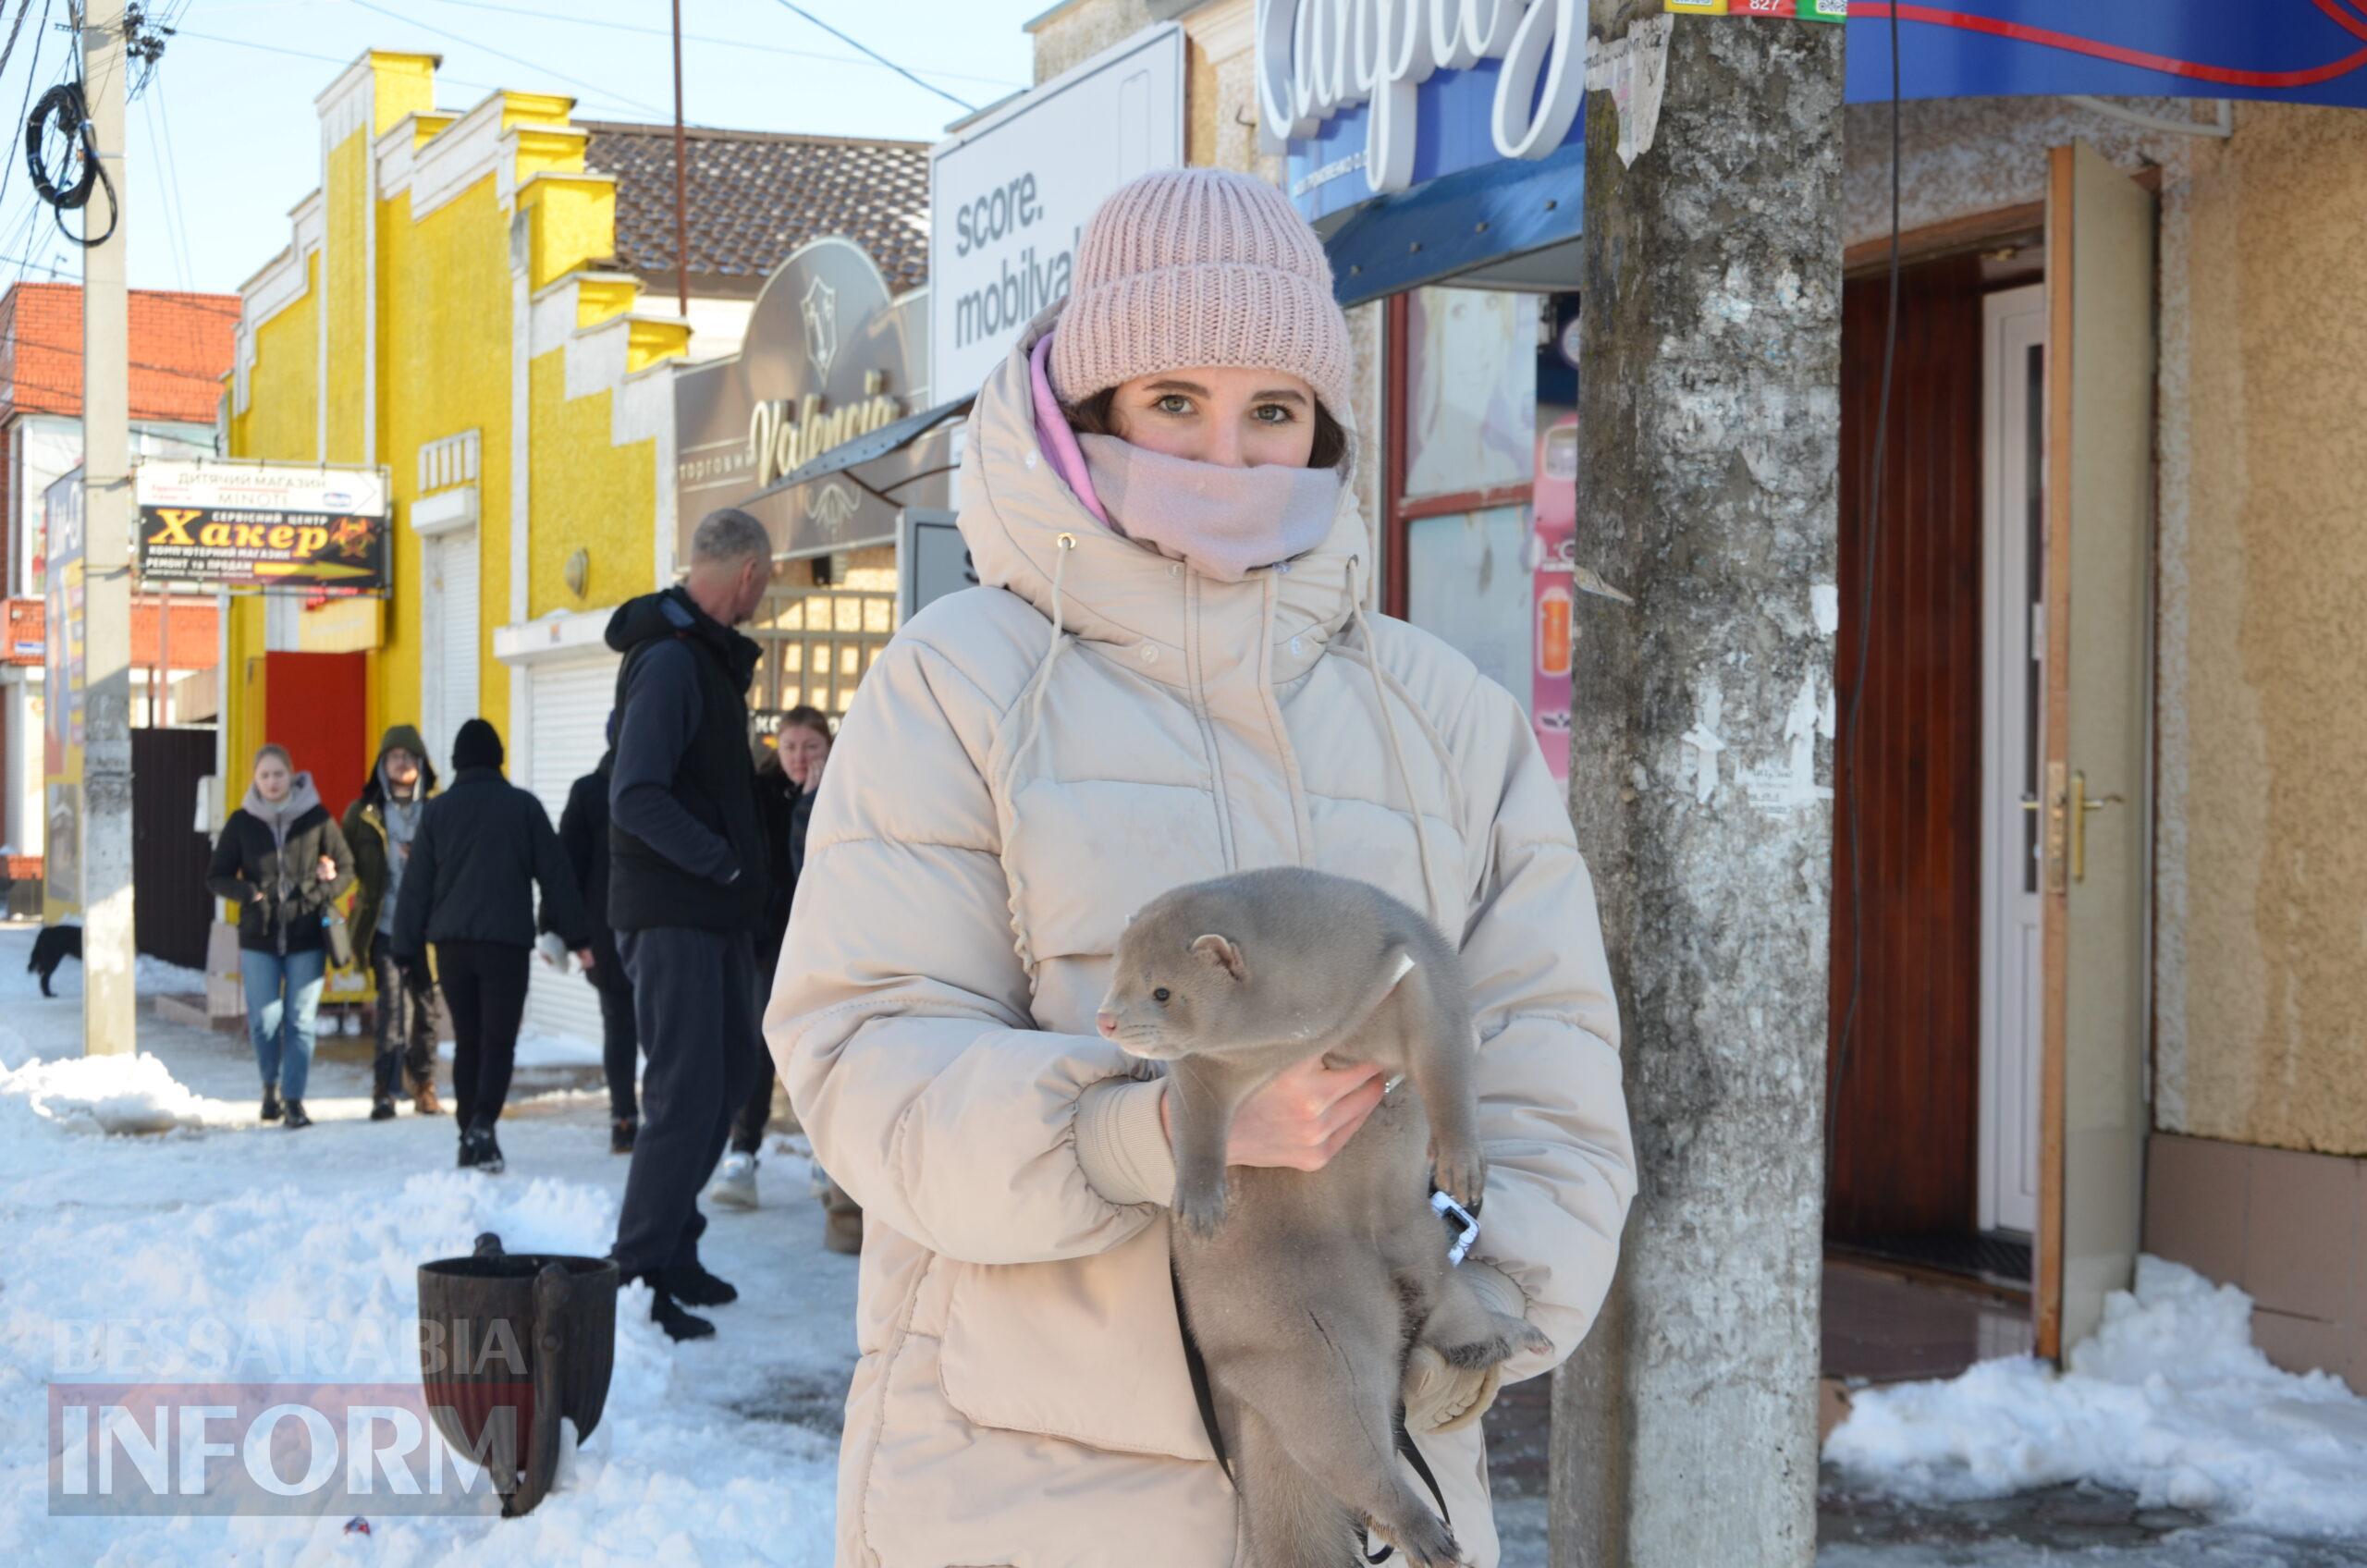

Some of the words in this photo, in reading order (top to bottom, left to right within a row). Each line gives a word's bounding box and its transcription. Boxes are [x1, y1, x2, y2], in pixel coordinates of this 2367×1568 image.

[956, 172, 1043, 258] score.
[178, 472, 251, 485] ДИТЯЧИЙ
[255, 476, 326, 488] МАГАЗИН
[212, 511, 282, 524] СЕРВІСНИЙ
[288, 514, 328, 527] ЦЕНТР
[147, 508, 329, 557] Хакер
[146, 557, 189, 570] РЕМОНТ
[207, 559, 252, 571] ПРОДАЖ
